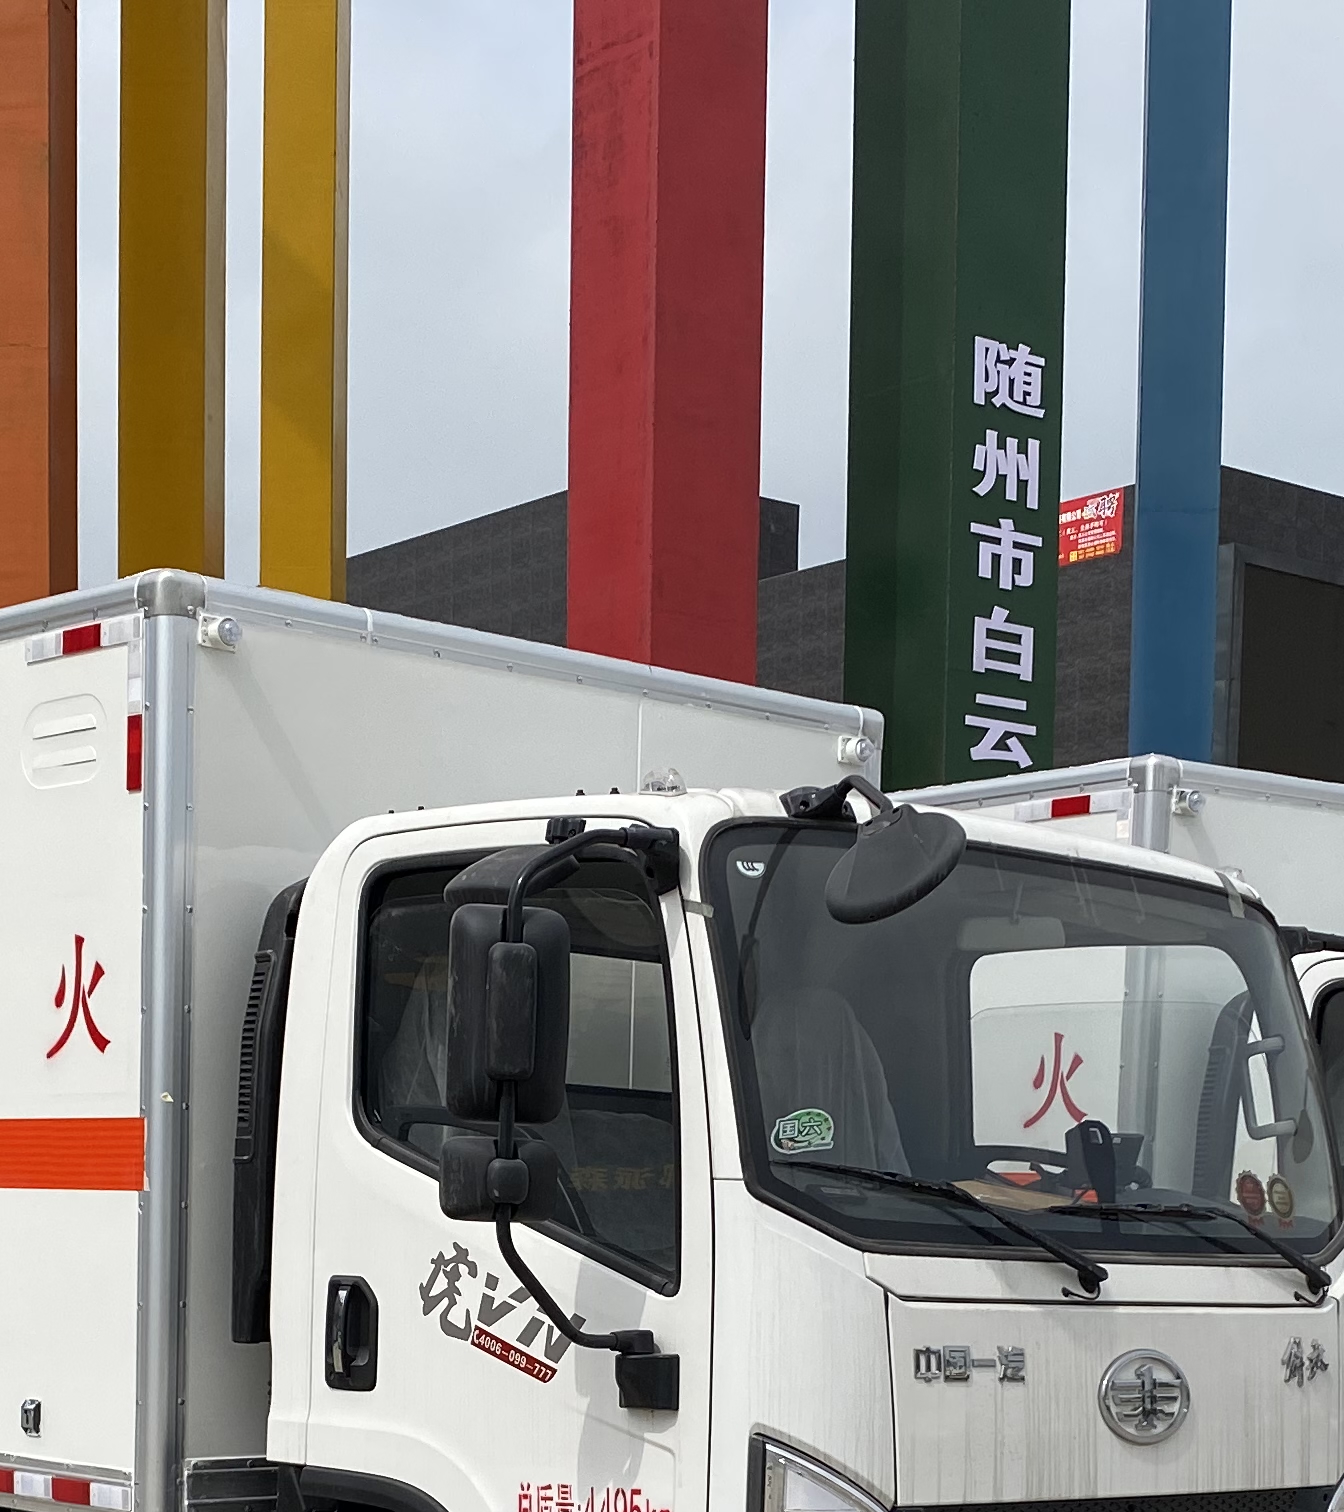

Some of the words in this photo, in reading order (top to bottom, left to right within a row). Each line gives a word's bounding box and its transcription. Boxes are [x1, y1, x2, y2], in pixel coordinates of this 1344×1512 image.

[964, 335, 1046, 769] 随州市白云
[1023, 1031, 1088, 1129] 火
[778, 1117, 822, 1139] 国六
[913, 1345, 1026, 1384] 中国一汽
